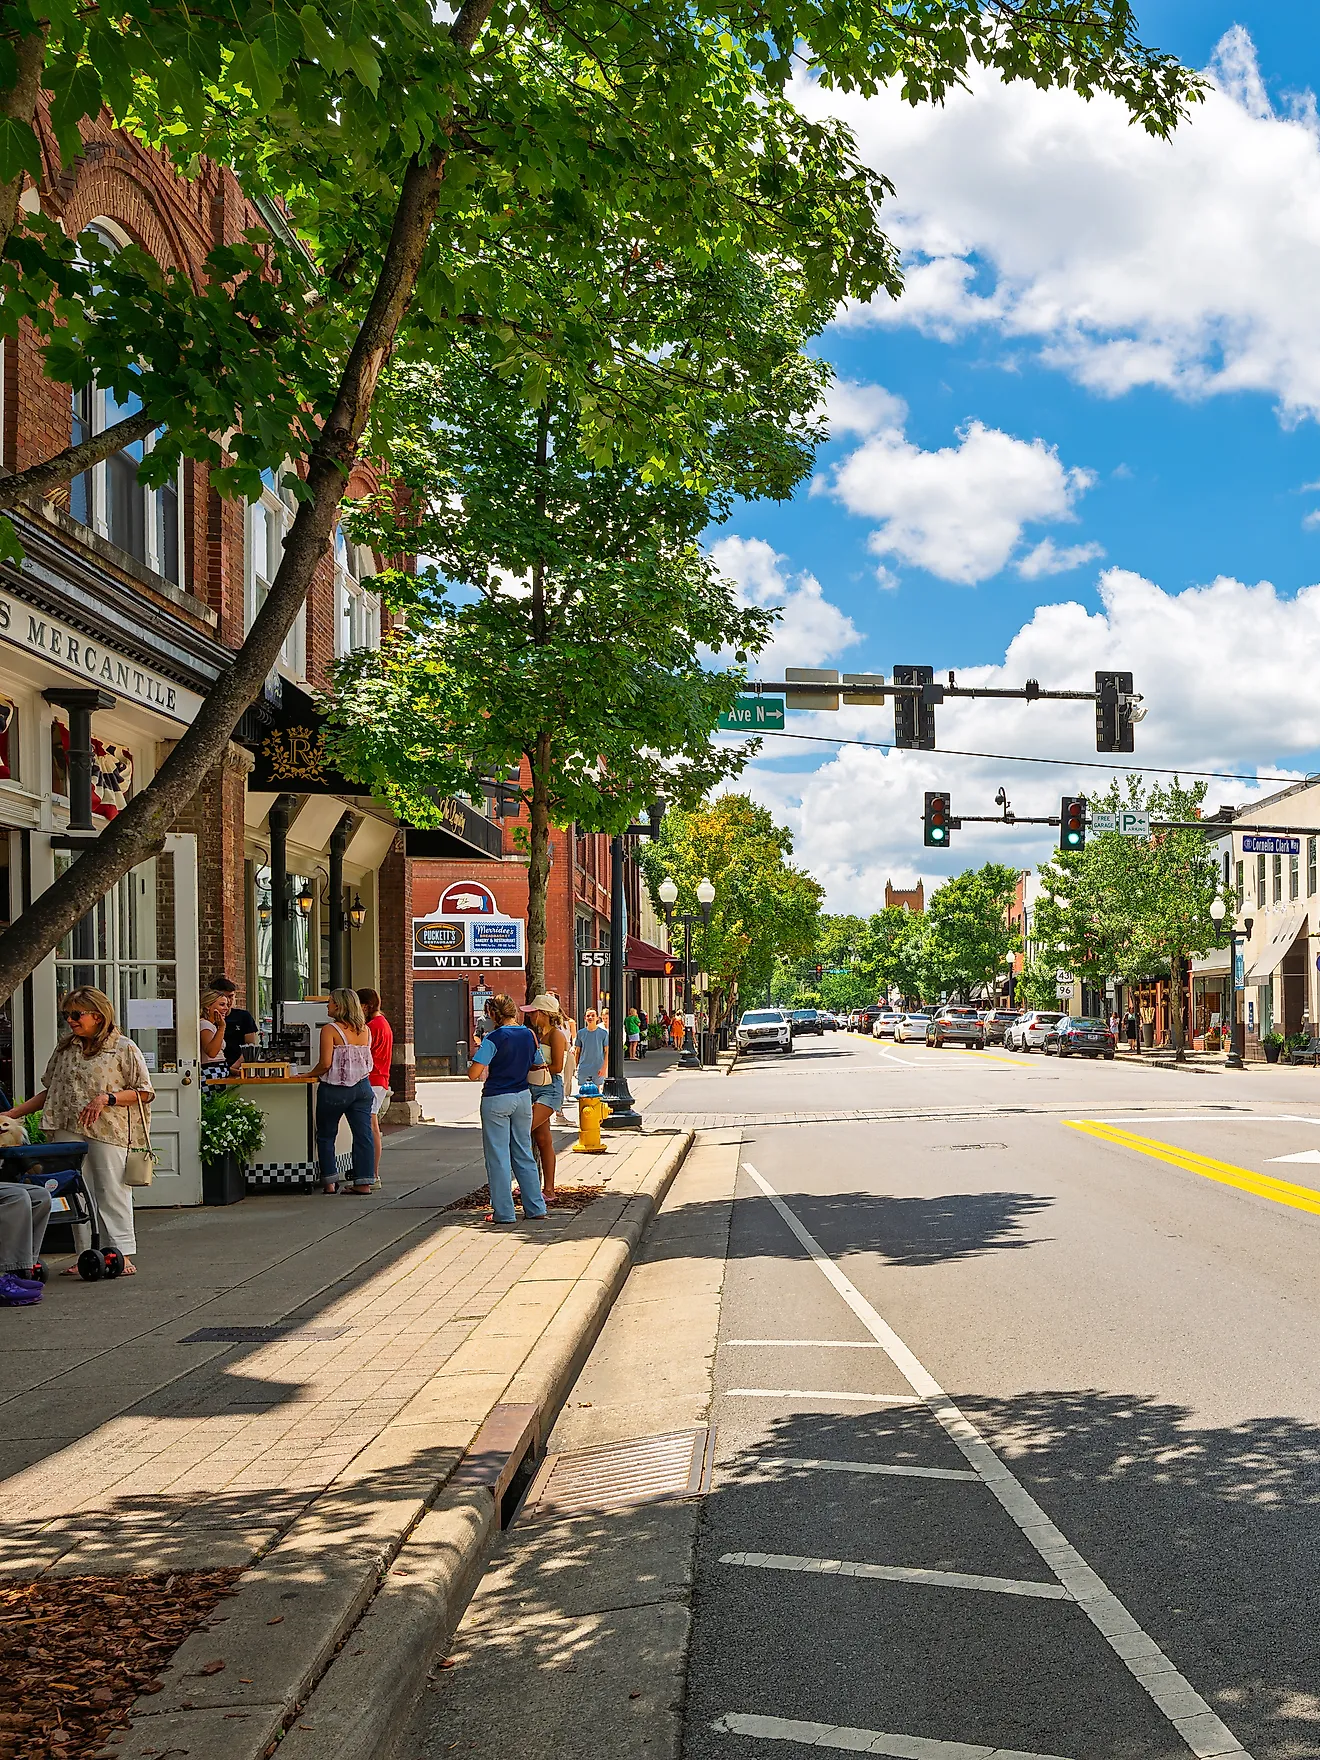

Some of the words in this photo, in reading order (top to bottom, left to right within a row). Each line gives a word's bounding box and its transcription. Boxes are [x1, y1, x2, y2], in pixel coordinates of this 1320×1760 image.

[27, 615, 176, 712] MERCANTILE
[728, 704, 751, 721] Ave
[756, 706, 765, 722] N
[1253, 838, 1274, 851] Cornelia
[1275, 839, 1290, 852] Clark
[1290, 840, 1299, 852] Way
[424, 929, 456, 941] PUCKETT'S
[475, 925, 515, 935] Merridee's
[435, 956, 502, 967] WILDER
[580, 952, 605, 967] 55
[1058, 971, 1073, 980] 431
[1059, 986, 1072, 995] 96
